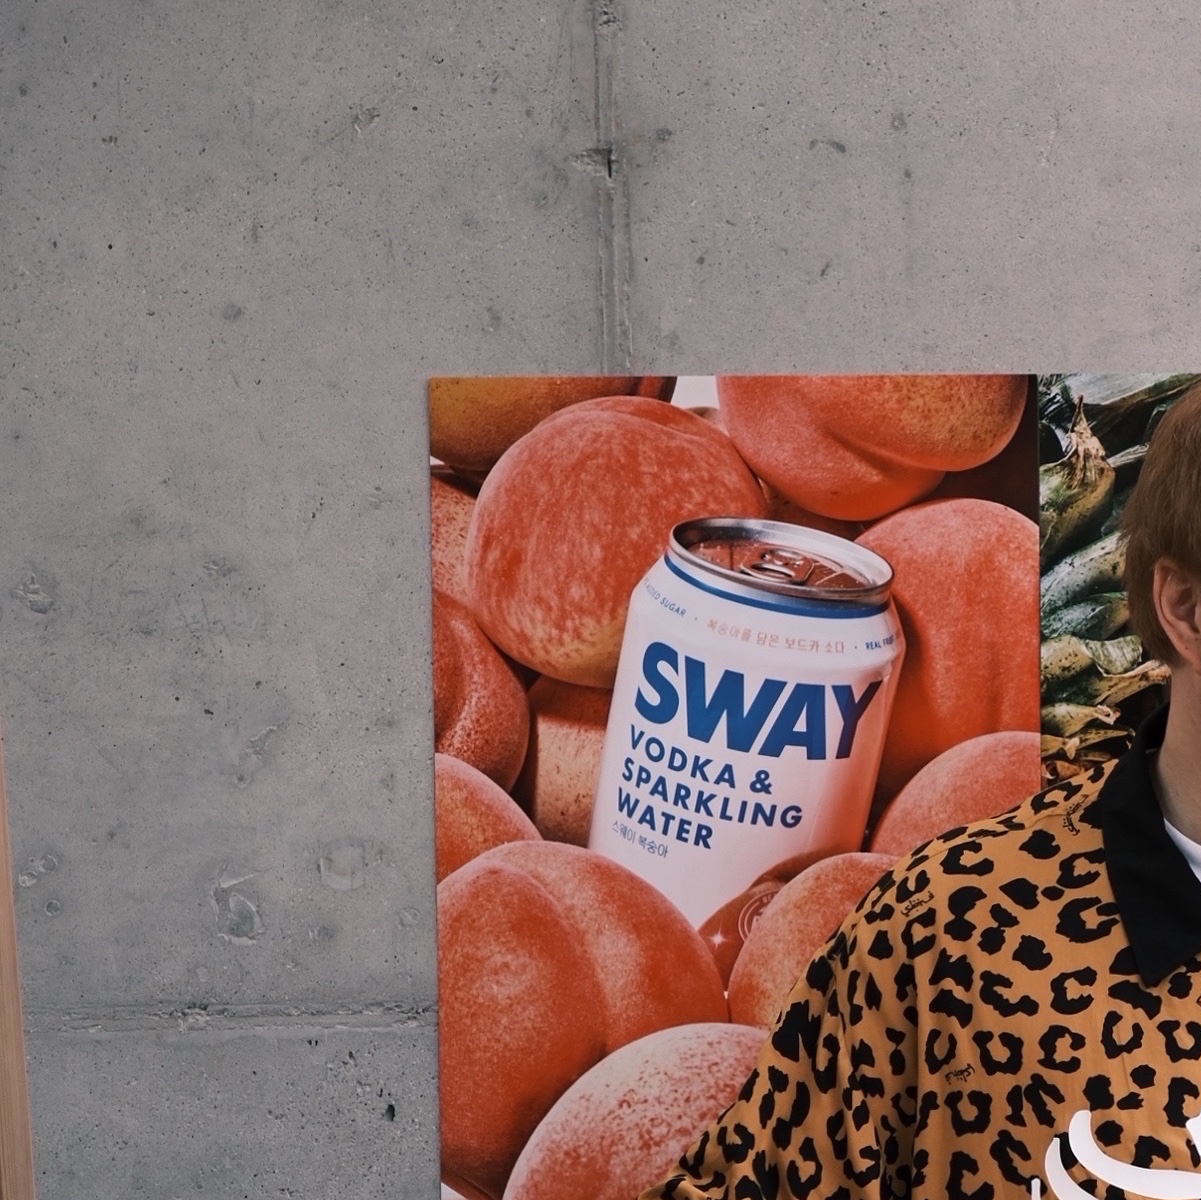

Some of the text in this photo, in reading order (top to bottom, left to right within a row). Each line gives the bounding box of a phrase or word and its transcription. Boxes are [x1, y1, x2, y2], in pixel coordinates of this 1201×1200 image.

[660, 596, 687, 617] SUGAR
[756, 631, 779, 648] 담은
[784, 636, 820, 654] 보드카
[824, 641, 845, 654] 소다
[865, 639, 882, 651] REAL
[634, 641, 883, 761] SWAY
[630, 723, 772, 795] VODKA &
[618, 786, 713, 849] WATER
[622, 757, 802, 828] SPARKLING
[611, 820, 669, 858] 스웨이 복숭아
